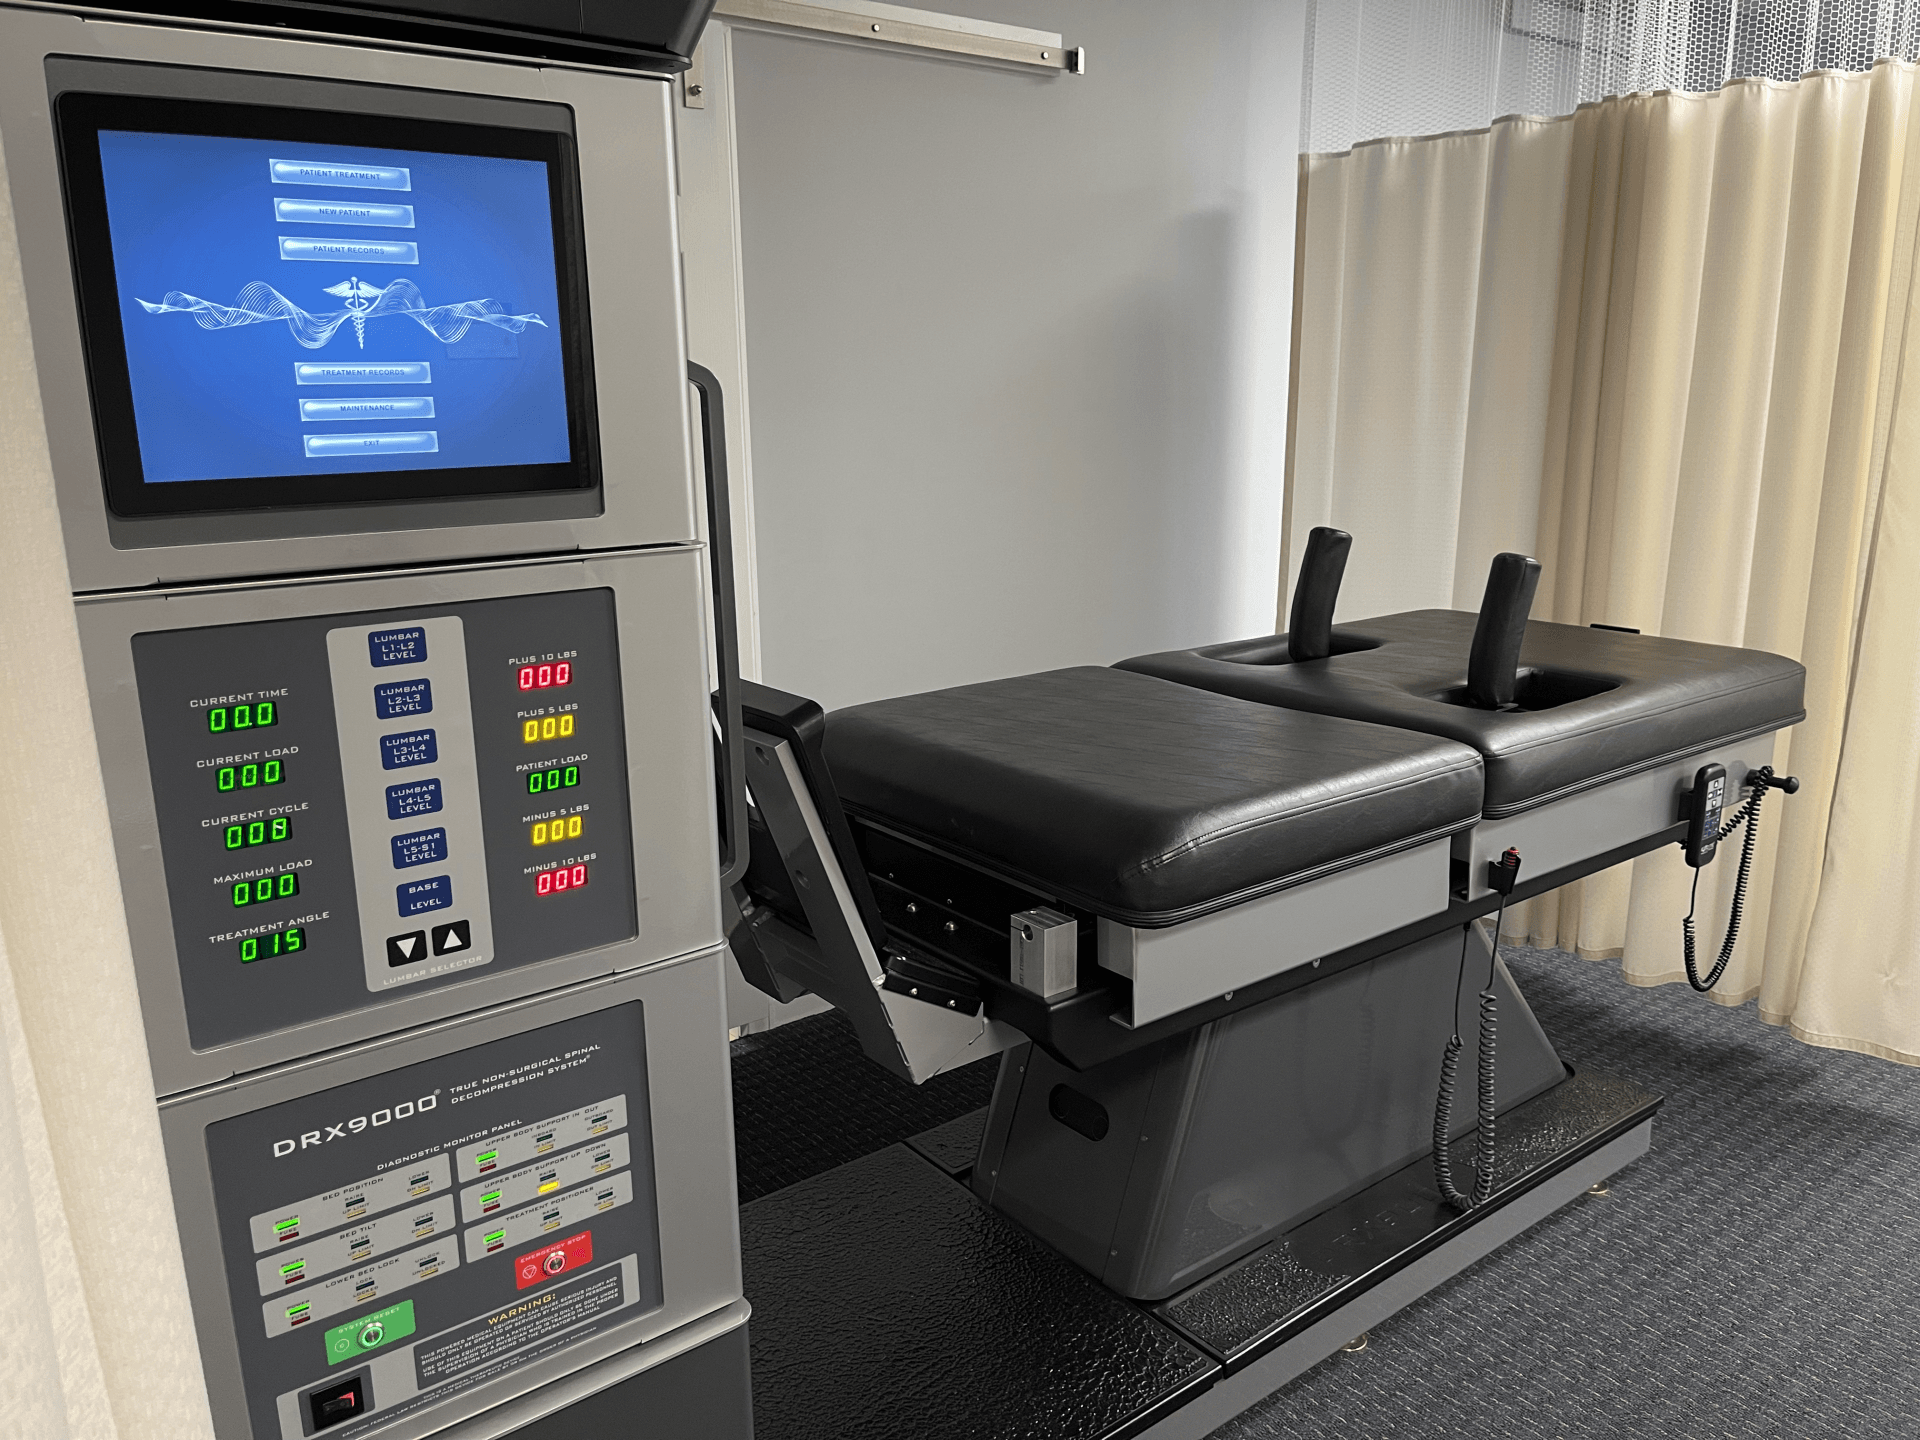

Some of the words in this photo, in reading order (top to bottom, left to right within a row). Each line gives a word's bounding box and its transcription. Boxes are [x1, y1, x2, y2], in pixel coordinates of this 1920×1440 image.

[300, 169, 332, 178] PATIENT
[335, 171, 381, 181] TREATMENT
[339, 209, 371, 217] PATIENT
[314, 245, 345, 253] PATIENT
[347, 247, 385, 255] RECORDS
[374, 631, 420, 643] LUMBAR
[381, 641, 415, 653] L1-L2
[383, 649, 417, 661] LEVEL
[508, 655, 536, 665] PLUS
[541, 653, 554, 661] 10
[557, 650, 577, 659] LBS
[519, 663, 569, 690] 000
[190, 692, 254, 708] CURRENT
[257, 688, 289, 699] TIME
[380, 684, 425, 696] LUMBAR
[387, 693, 421, 705] L2-L3
[210, 702, 273, 732] 00.0
[389, 702, 422, 714] LEVEL
[517, 708, 545, 718] PLUS
[548, 706, 555, 714] 5
[558, 703, 579, 712] LBS
[524, 715, 574, 742] 000
[386, 734, 430, 747] LUMBAR
[393, 744, 426, 756] L3-L4
[196, 752, 261, 769] CURRENT
[264, 746, 299, 758] LOAD
[394, 752, 427, 764] LEVEL
[516, 759, 558, 772] PATIENT
[561, 753, 588, 764] LOAD
[219, 760, 280, 790] 000
[529, 767, 577, 793] 000
[392, 784, 436, 798] LUMBAR
[399, 794, 432, 806] L4-L5
[201, 810, 265, 828] CURRENT
[269, 802, 309, 816] CYCLE
[400, 802, 433, 814] LEVEL
[522, 809, 556, 823] MINUS
[570, 804, 590, 813] LBS
[397, 833, 441, 846] LUMBAR
[533, 816, 582, 845] 000
[404, 842, 435, 855] L5-S1
[405, 850, 438, 863] LEVEL
[213, 866, 274, 885] MAXIMUM
[279, 859, 313, 872] LOAD
[524, 861, 557, 874] MINUS
[561, 858, 575, 867] 10
[577, 853, 597, 863] LBS
[409, 882, 439, 894] BASE
[538, 865, 585, 894] 000
[233, 874, 294, 906] 000
[410, 897, 442, 911] LEVEL
[209, 921, 284, 944] TREATMENT
[288, 911, 330, 927] ANGLE
[241, 929, 300, 963] 015
[383, 969, 427, 986] LUMBAR
[430, 956, 483, 974] SELECTOR
[450, 1080, 478, 1094] TRUE
[482, 1056, 562, 1085] NON-SURGICAL
[564, 1044, 601, 1059] SPINAL
[451, 1071, 544, 1104] DECOMPRESSION
[485, 1135, 511, 1147] UPPER
[513, 1127, 534, 1139] BODY
[536, 1115, 570, 1130] SUPPORT
[584, 1105, 599, 1114] OUT
[377, 1145, 440, 1171] DIAGNOSTIC
[443, 1129, 488, 1149] MONITOR
[491, 1119, 523, 1137] PANEL
[592, 1149, 611, 1158] LOWER
[408, 1170, 430, 1180] LOWER
[484, 1177, 510, 1189] UPPER
[512, 1169, 533, 1180] BODY
[535, 1156, 569, 1172] SUPPORT
[570, 1151, 581, 1159] UP
[585, 1143, 607, 1154] DOWN
[322, 1191, 340, 1201] BED
[343, 1177, 384, 1194] POSITION
[595, 1186, 613, 1196] LOWER
[505, 1202, 549, 1221] TREATMENT
[551, 1186, 594, 1207] POSITIONER
[413, 1212, 434, 1222] LOWER
[339, 1229, 357, 1240] BED
[360, 1223, 377, 1233] TILT
[520, 1243, 566, 1264] EMERGENCY
[567, 1234, 586, 1246] STOP
[325, 1274, 355, 1289] LOWER
[358, 1266, 375, 1277] BED
[378, 1257, 400, 1269] LOCK
[412, 1260, 446, 1275] UNLOCKED
[353, 1286, 379, 1298] LOCKED
[420, 1351, 435, 1360] THIS
[436, 1339, 465, 1354] POWERED
[466, 1328, 492, 1342] MEDICAL
[493, 1314, 526, 1331] EQUIPMENT
[527, 1308, 539, 1316] CAN
[540, 1300, 559, 1311] CAUSE
[560, 1290, 585, 1302] SERIOUS
[585, 1282, 605, 1293] INJURY
[606, 1276, 618, 1284] AND
[487, 1293, 556, 1326] WARNING:
[338, 1318, 371, 1334] SYSTEM
[373, 1307, 400, 1320] RESET
[421, 1352, 446, 1366] SHOULD
[447, 1346, 463, 1355] ONLY
[474, 1328, 504, 1344] OPERATED
[515, 1313, 542, 1326] SERVICED
[551, 1295, 584, 1311] AUTHORIZED
[585, 1282, 617, 1297] PERSONNEL
[422, 1364, 436, 1373] USE
[446, 1354, 460, 1363] THIS
[461, 1341, 495, 1356] EQUIPMENT
[511, 1323, 534, 1335] PATIENT
[535, 1312, 559, 1324] SHOULD
[559, 1306, 574, 1315] ONLY
[583, 1296, 599, 1306] DONE
[600, 1288, 619, 1298] UNDER
[423, 1369, 436, 1378] THE
[437, 1352, 479, 1372] SUPERVISION
[496, 1329, 528, 1347] PHYSICIAN
[529, 1324, 543, 1333] WHO
[551, 1311, 576, 1324] TRAINED
[584, 1302, 596, 1310] THE
[596, 1293, 619, 1305] PROPER
[445, 1357, 480, 1374] OPERATION
[481, 1341, 517, 1359] ACCORDING
[527, 1331, 540, 1339] THE
[540, 1316, 577, 1334] OPERATOR'S
[577, 1306, 601, 1318] MANUAL
